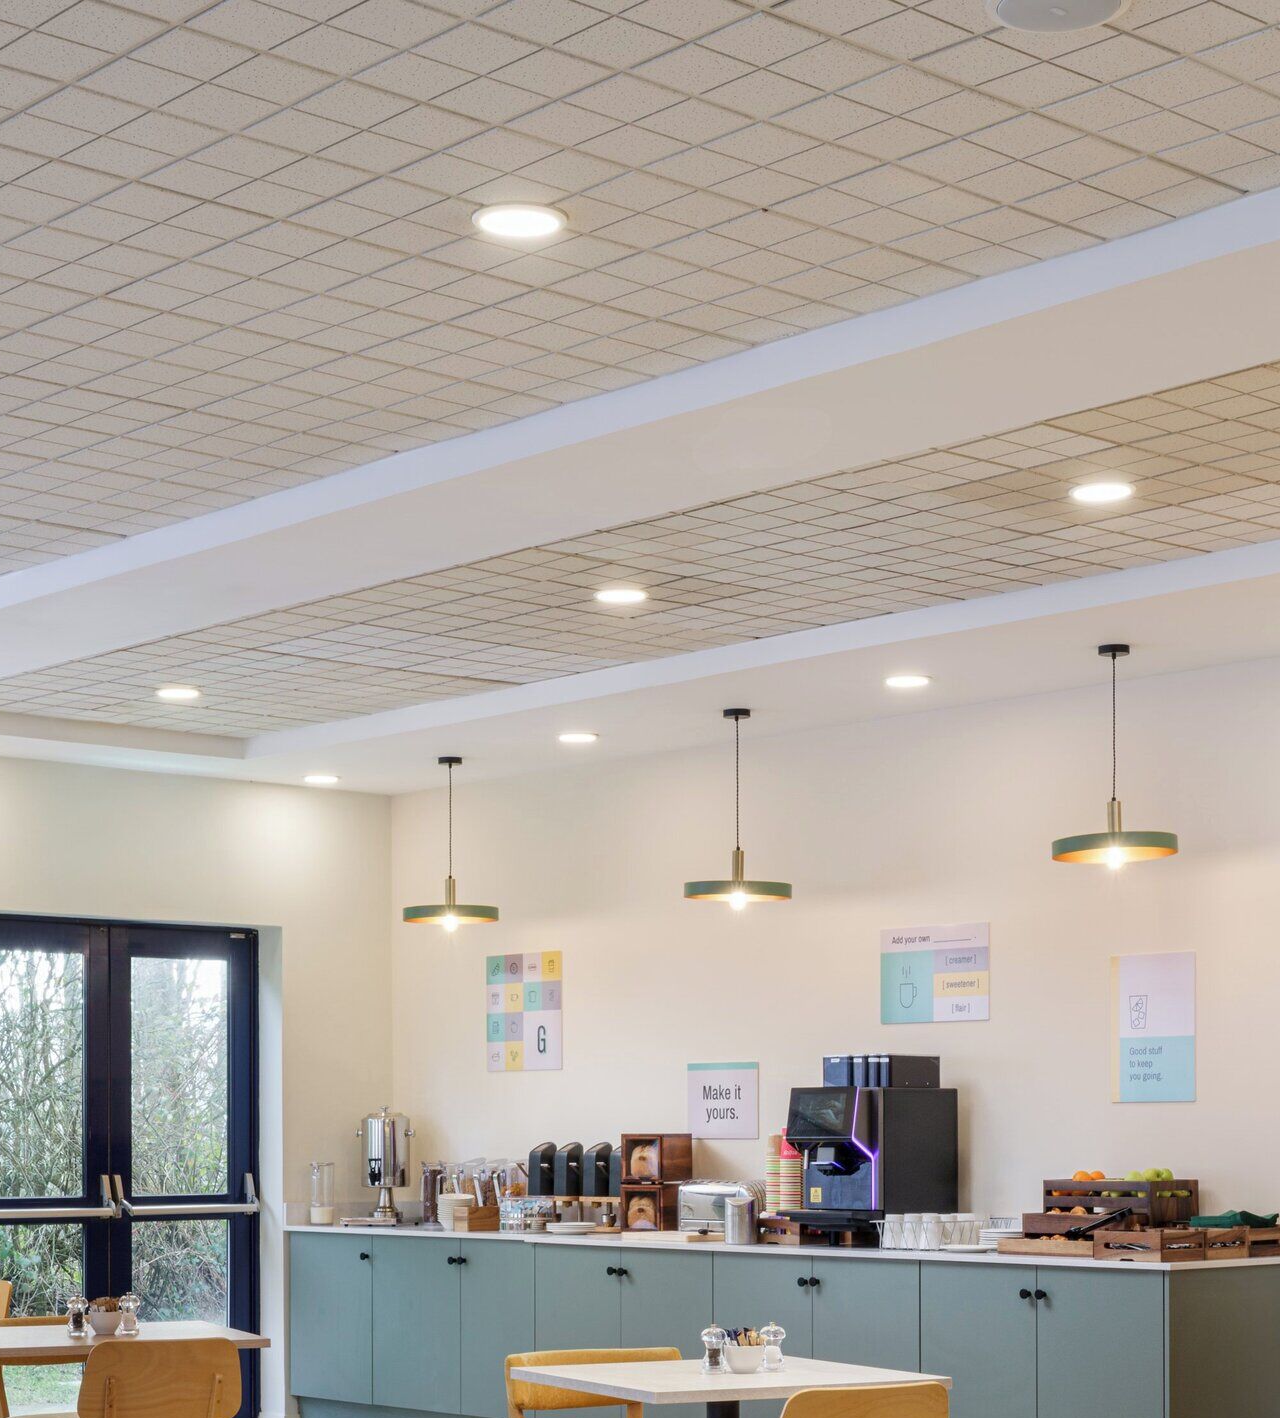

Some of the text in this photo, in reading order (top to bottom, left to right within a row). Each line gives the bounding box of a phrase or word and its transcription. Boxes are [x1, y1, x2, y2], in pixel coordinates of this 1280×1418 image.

[891, 935, 930, 946] Add your own
[537, 1025, 546, 1054] G
[1129, 1045, 1163, 1056] Good stuff
[1129, 1060, 1153, 1069] to keep
[1129, 1073, 1141, 1082] you
[702, 1083, 742, 1101] Make it
[706, 1107, 739, 1123] yours.
